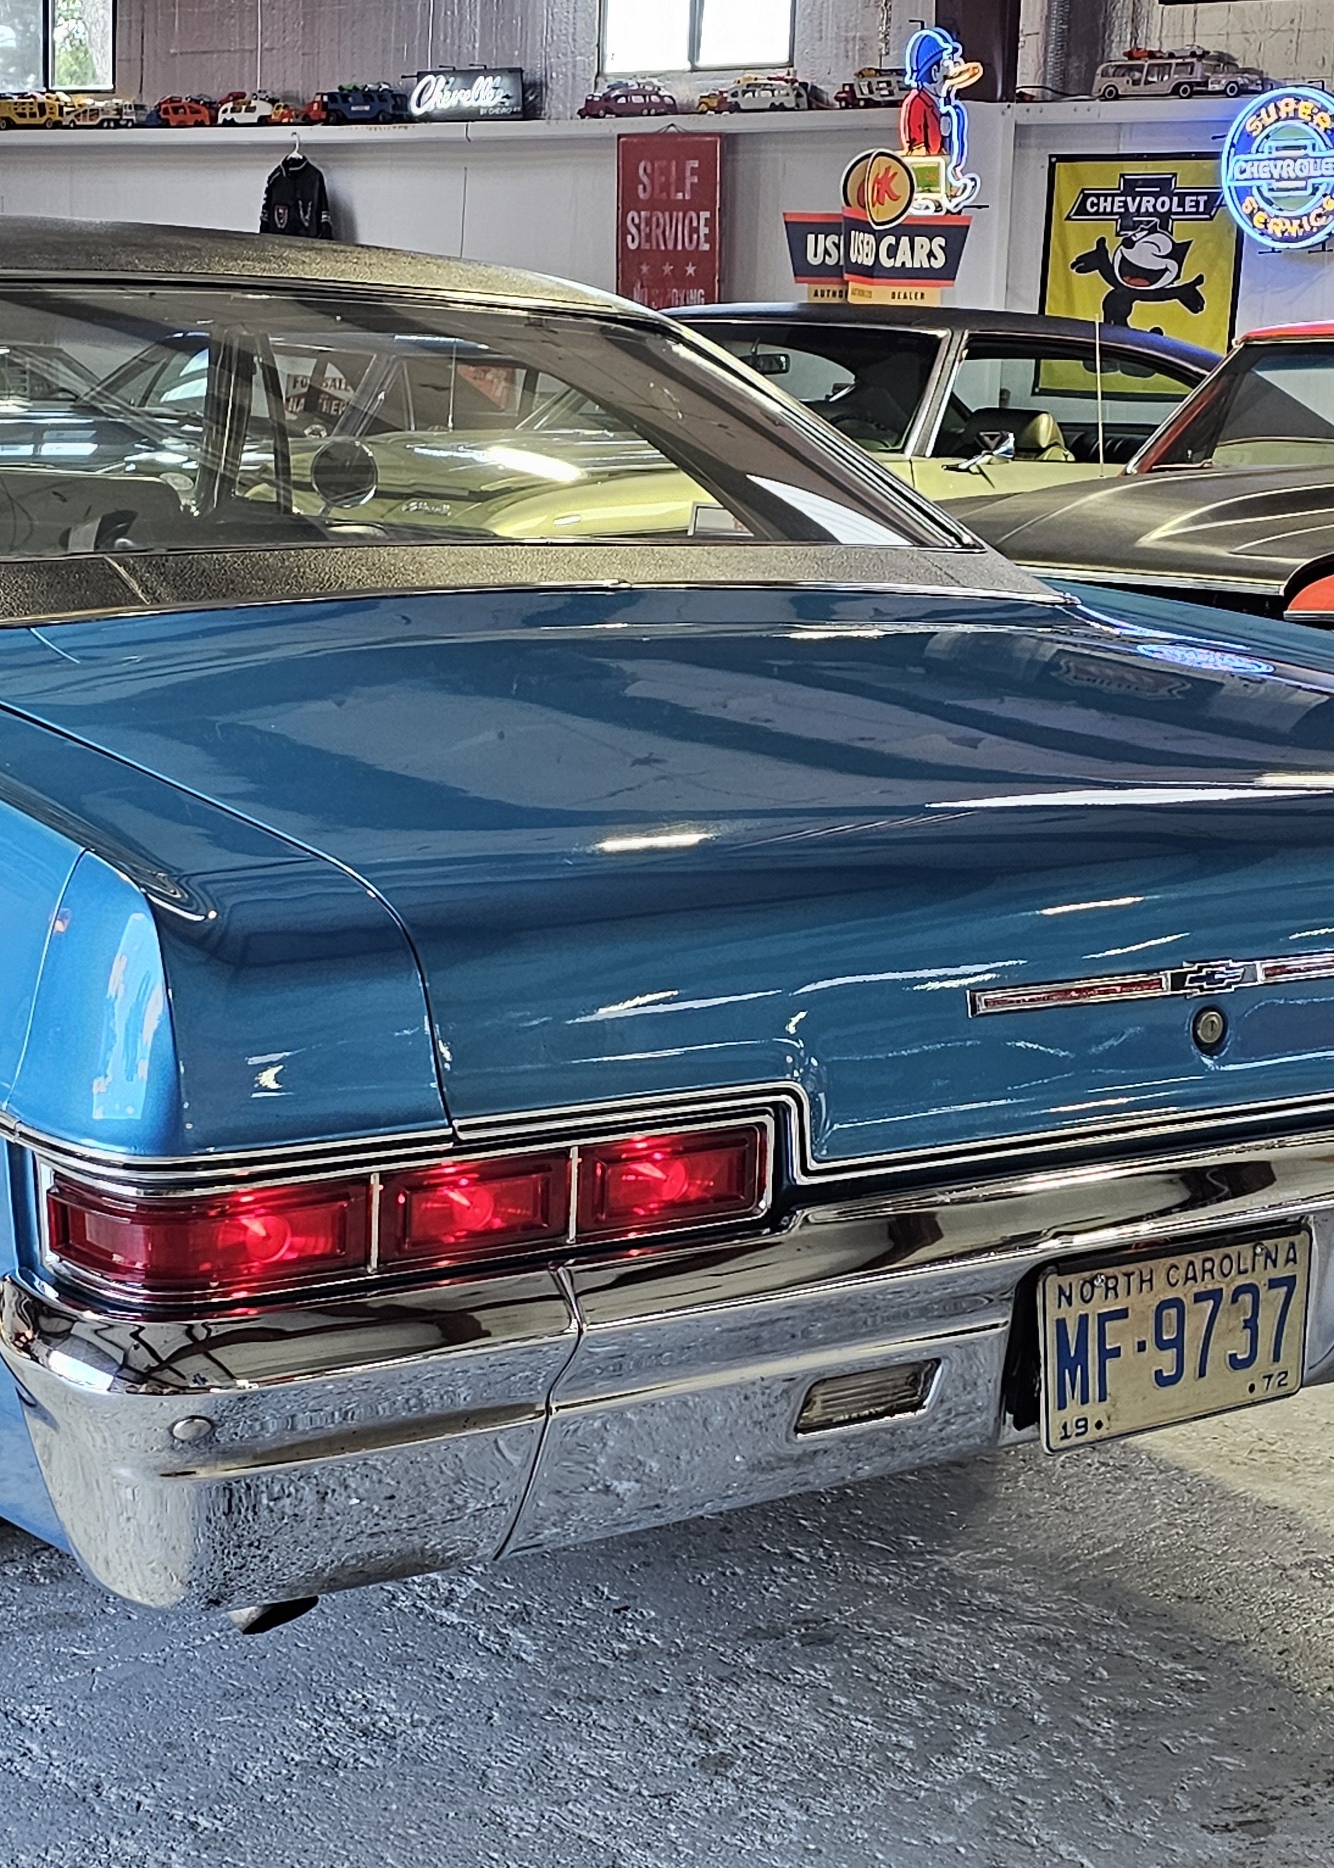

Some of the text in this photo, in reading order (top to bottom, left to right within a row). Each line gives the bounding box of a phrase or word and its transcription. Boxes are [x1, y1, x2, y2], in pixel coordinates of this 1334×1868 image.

[638, 160, 699, 199] SELF
[1086, 195, 1208, 214] CHEVROLET
[627, 210, 710, 250] SERVICE
[850, 230, 946, 268] USED CARS
[891, 291, 926, 300] DEALER
[1057, 1241, 1298, 1309] NORTH CAROLINA
[1262, 1370, 1289, 1391] 72
[1059, 1416, 1089, 1440] 19
